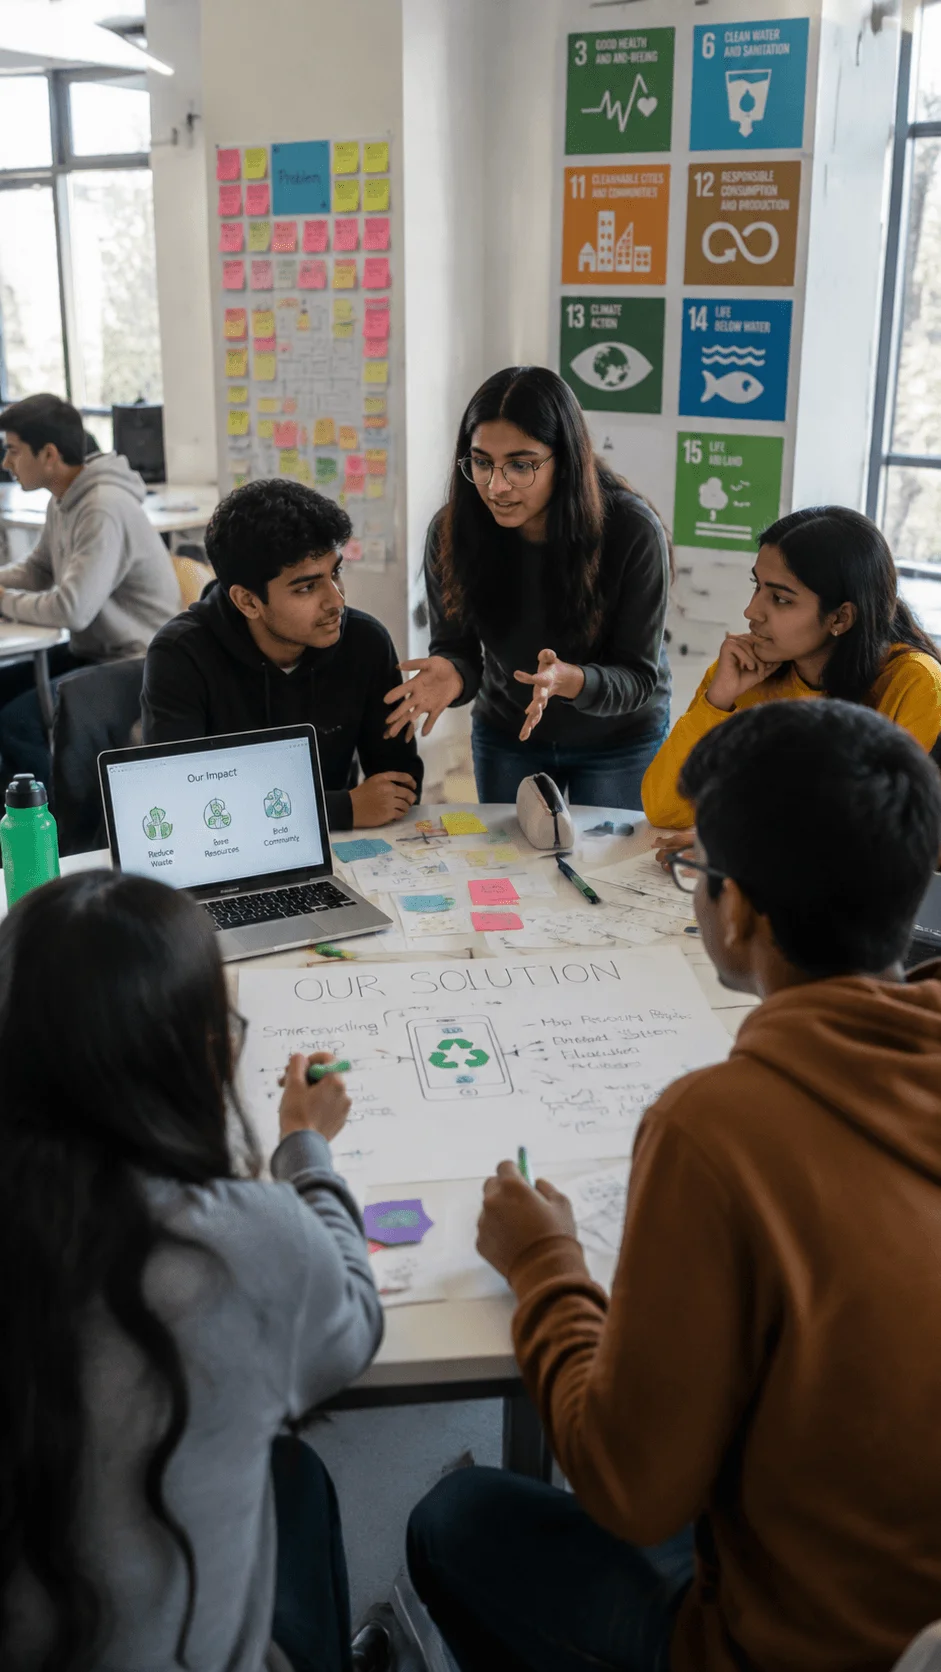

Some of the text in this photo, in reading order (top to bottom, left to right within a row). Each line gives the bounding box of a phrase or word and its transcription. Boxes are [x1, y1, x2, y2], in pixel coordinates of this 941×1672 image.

[724, 28, 780, 43] CLEAN WATER
[574, 40, 587, 66] 3
[702, 32, 716, 59] 6
[724, 43, 790, 58] AND SANITATION
[279, 169, 321, 185] Problem
[694, 171, 715, 197] 12
[721, 170, 774, 183] RESPONSIBLE
[570, 174, 586, 199] 11
[720, 184, 779, 197] CONSUMPTION
[739, 198, 790, 211] PRODUCTION
[566, 303, 585, 329] 13
[590, 303, 622, 316] CLIMATE
[714, 305, 732, 318] LIFE
[590, 317, 618, 329] ACTION
[688, 305, 708, 332] 14
[714, 320, 743, 332] BELOW
[683, 439, 703, 465] 15
[708, 440, 726, 453] LIFE
[187, 768, 237, 783] Our Impact
[147, 849, 175, 859] Reduce
[150, 858, 174, 868] Waste
[293, 960, 622, 1002] OUR SOLUTION
